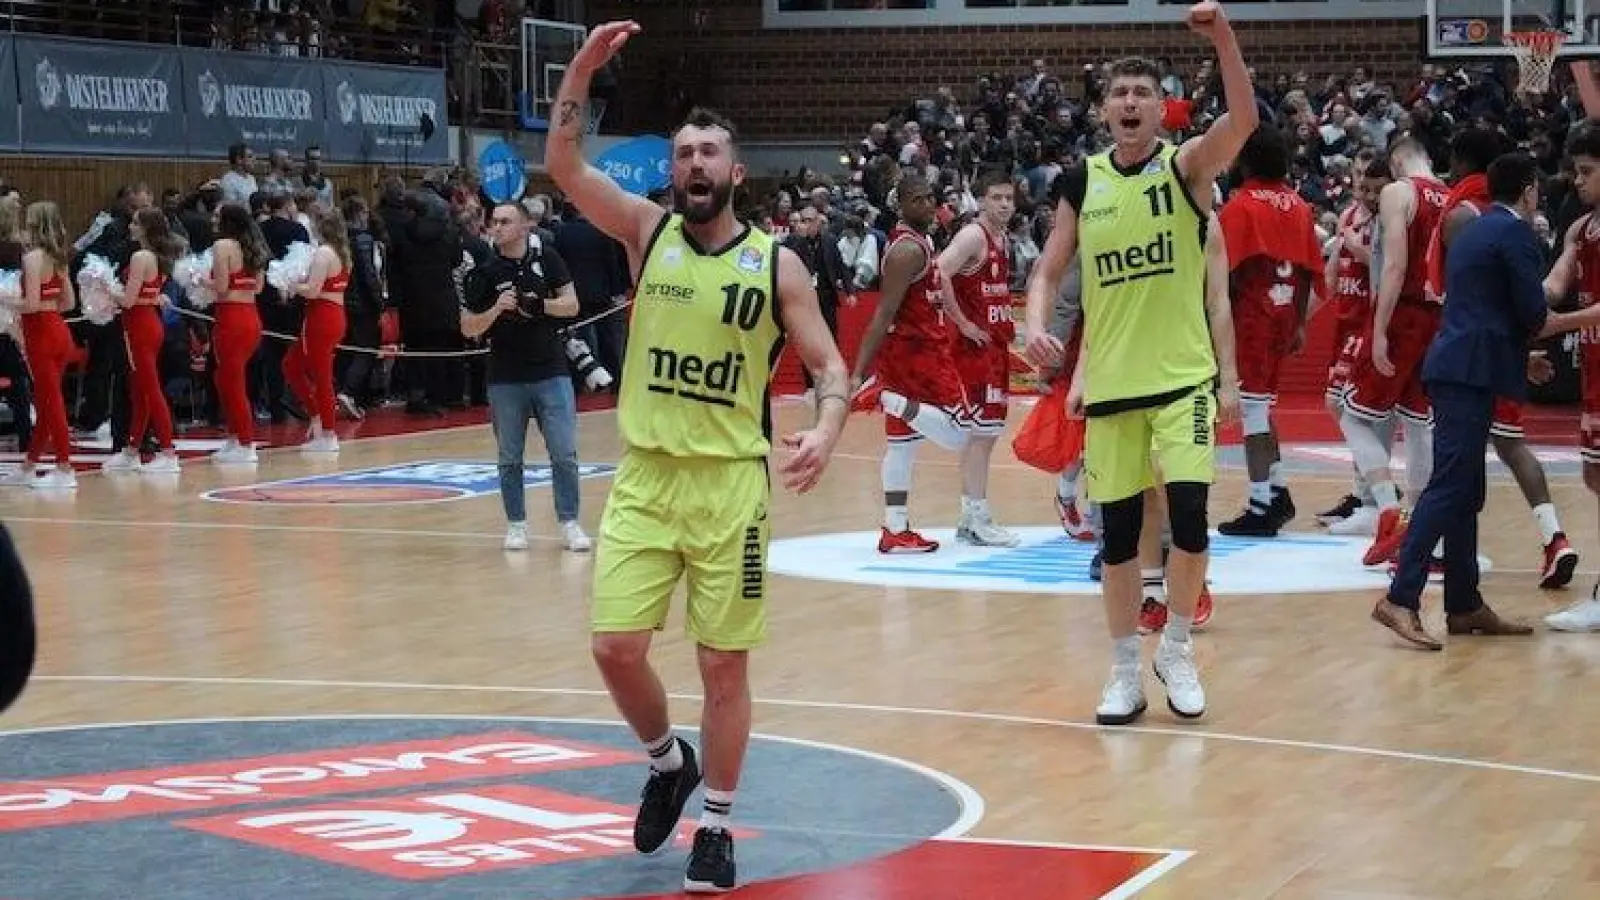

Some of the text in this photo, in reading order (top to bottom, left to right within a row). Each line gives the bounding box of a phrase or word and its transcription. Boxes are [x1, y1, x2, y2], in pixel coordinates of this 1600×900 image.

[1143, 182, 1174, 216] 11
[1094, 230, 1174, 277] medi
[720, 283, 765, 330] 10
[648, 347, 745, 394] medi
